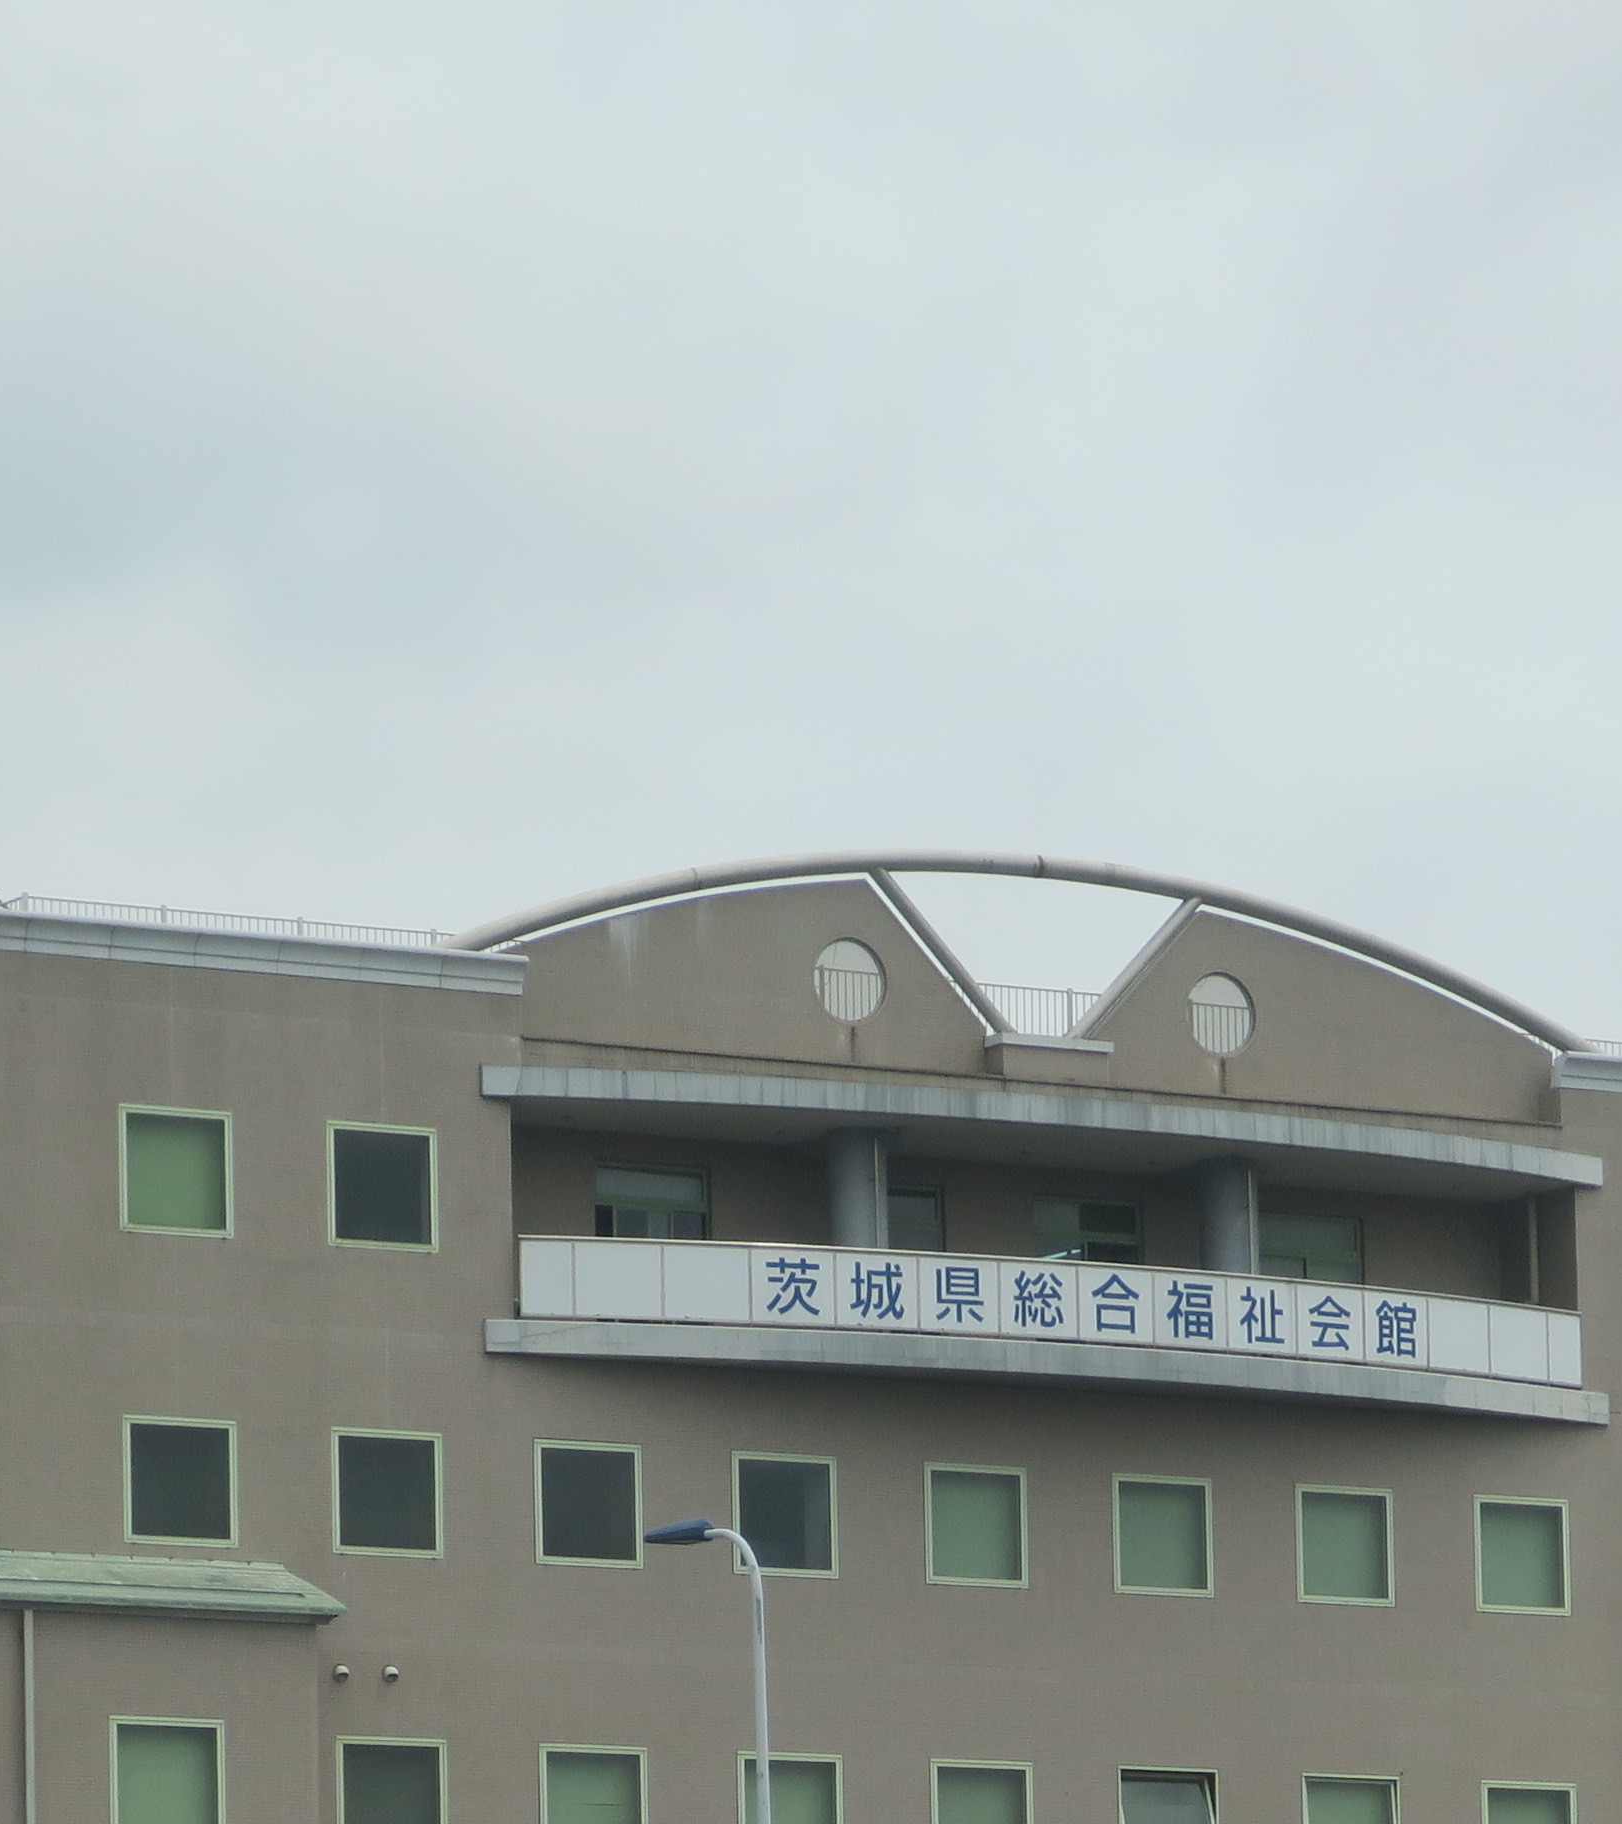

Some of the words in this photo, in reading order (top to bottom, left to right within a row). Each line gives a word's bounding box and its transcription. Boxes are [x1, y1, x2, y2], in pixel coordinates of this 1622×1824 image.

[765, 1256, 1417, 1358] 茨城県総合福祉会館
